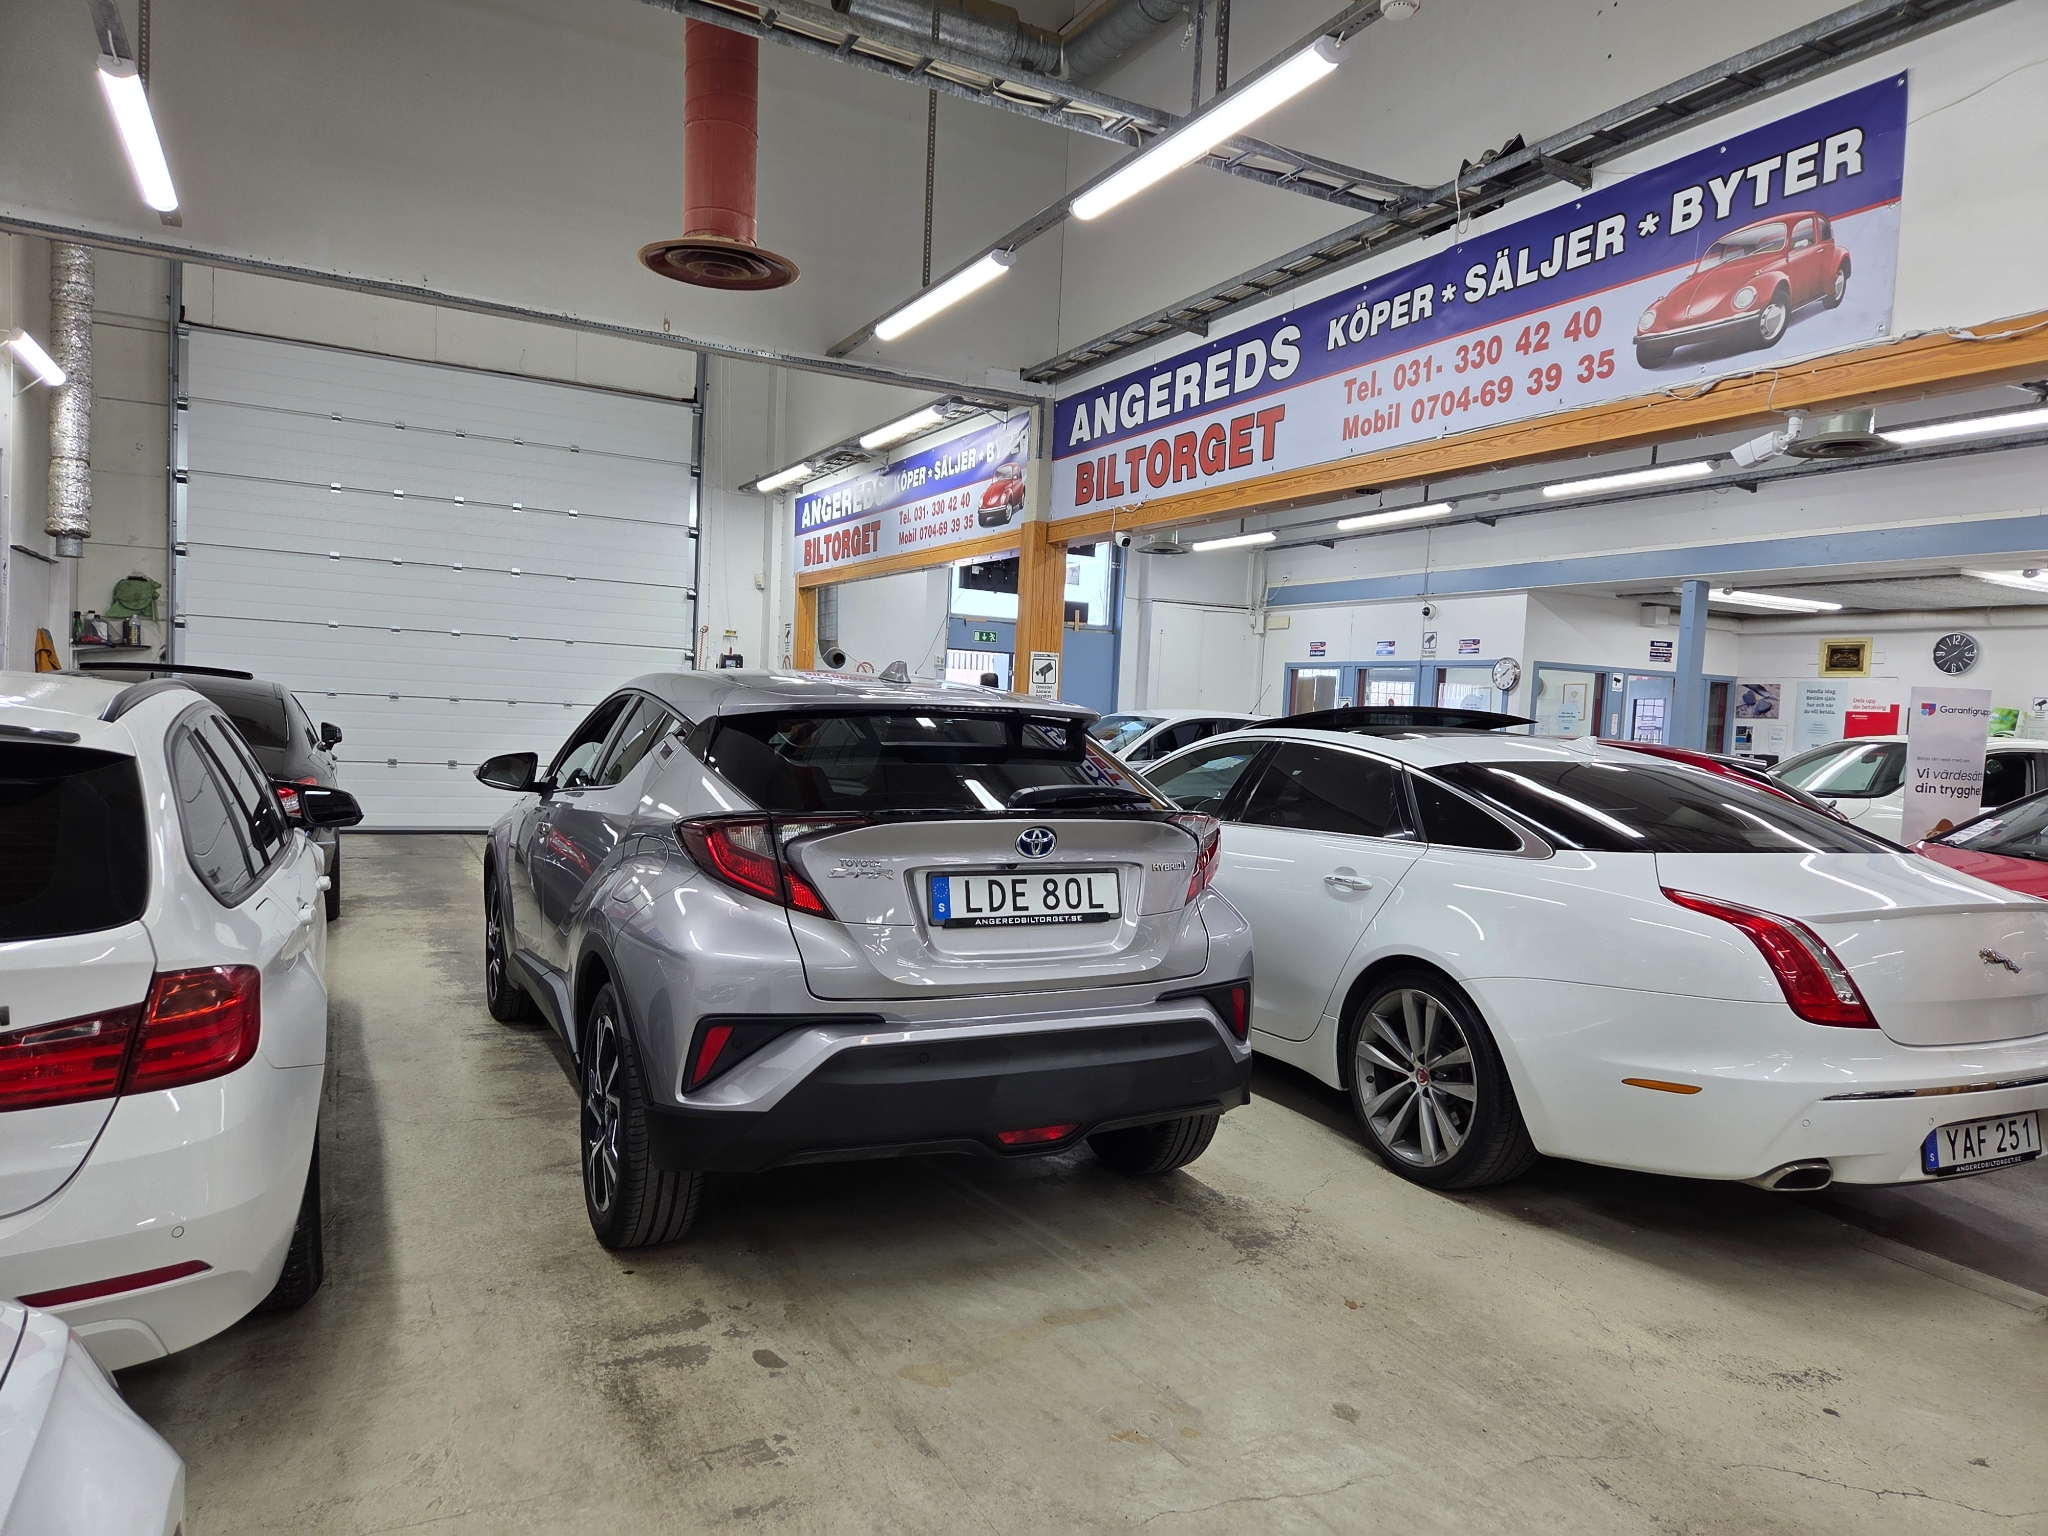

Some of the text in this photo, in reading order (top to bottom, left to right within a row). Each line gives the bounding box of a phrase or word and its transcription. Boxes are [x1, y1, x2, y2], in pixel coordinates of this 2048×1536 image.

[1068, 126, 1864, 447] ANGEREDS KÖPER SÄLJER BYTER
[1344, 306, 1602, 405] Tel. 031- 330 42 40
[1342, 349, 1615, 440] Mobil 0704-69 39 35
[1074, 404, 1286, 506] BILTORGET
[801, 476, 887, 528] ANGEREDS
[894, 466, 926, 493] KÖPER
[934, 448, 976, 480] SÄLJER
[899, 492, 970, 525] Tel. 031- 330 42 40
[804, 520, 882, 567] BILTORGET
[898, 514, 974, 545] Mobil 0704-69 39 35
[1952, 634, 1960, 644] 12
[1952, 663, 1956, 672] 6
[1915, 783, 1936, 794] din
[1917, 768, 1930, 779] Vi
[839, 858, 882, 867] TOYOTA
[1152, 862, 1181, 871] HYBRID
[938, 877, 1104, 913] S LDE 80L
[975, 915, 1082, 926] ANGEREDBILTORGET.SE
[1930, 1118, 2030, 1162] S YAF 251
[1956, 1156, 2022, 1172] ANGEREDBILTORGET.SE
